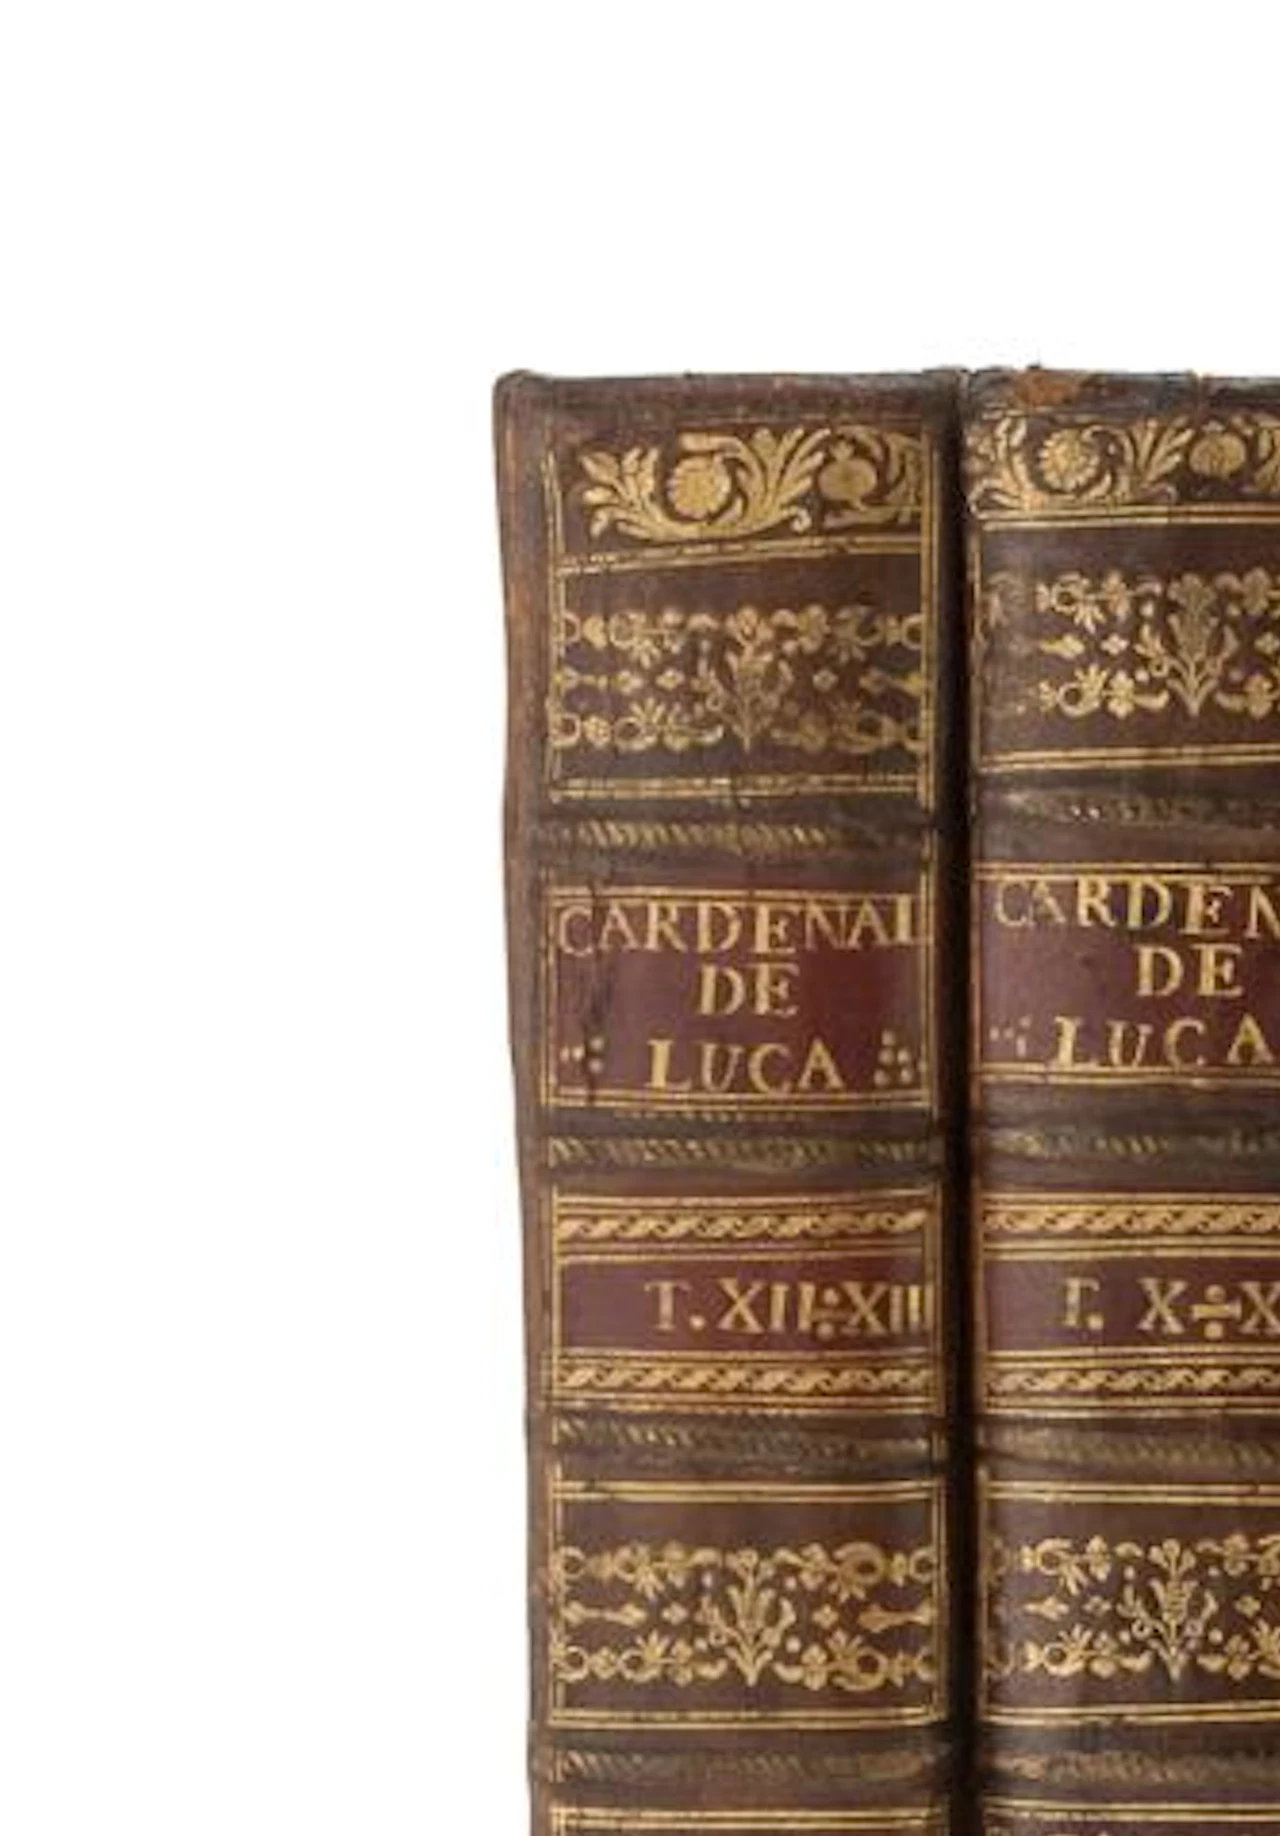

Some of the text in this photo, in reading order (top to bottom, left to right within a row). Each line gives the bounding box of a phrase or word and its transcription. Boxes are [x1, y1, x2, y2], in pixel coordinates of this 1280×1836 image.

[558, 893, 934, 955] CARDENAL
[699, 963, 799, 1017] DE
[1136, 943, 1245, 998] DE
[648, 1037, 845, 1094] LUCA
[1051, 1013, 1274, 1068] LUCA
